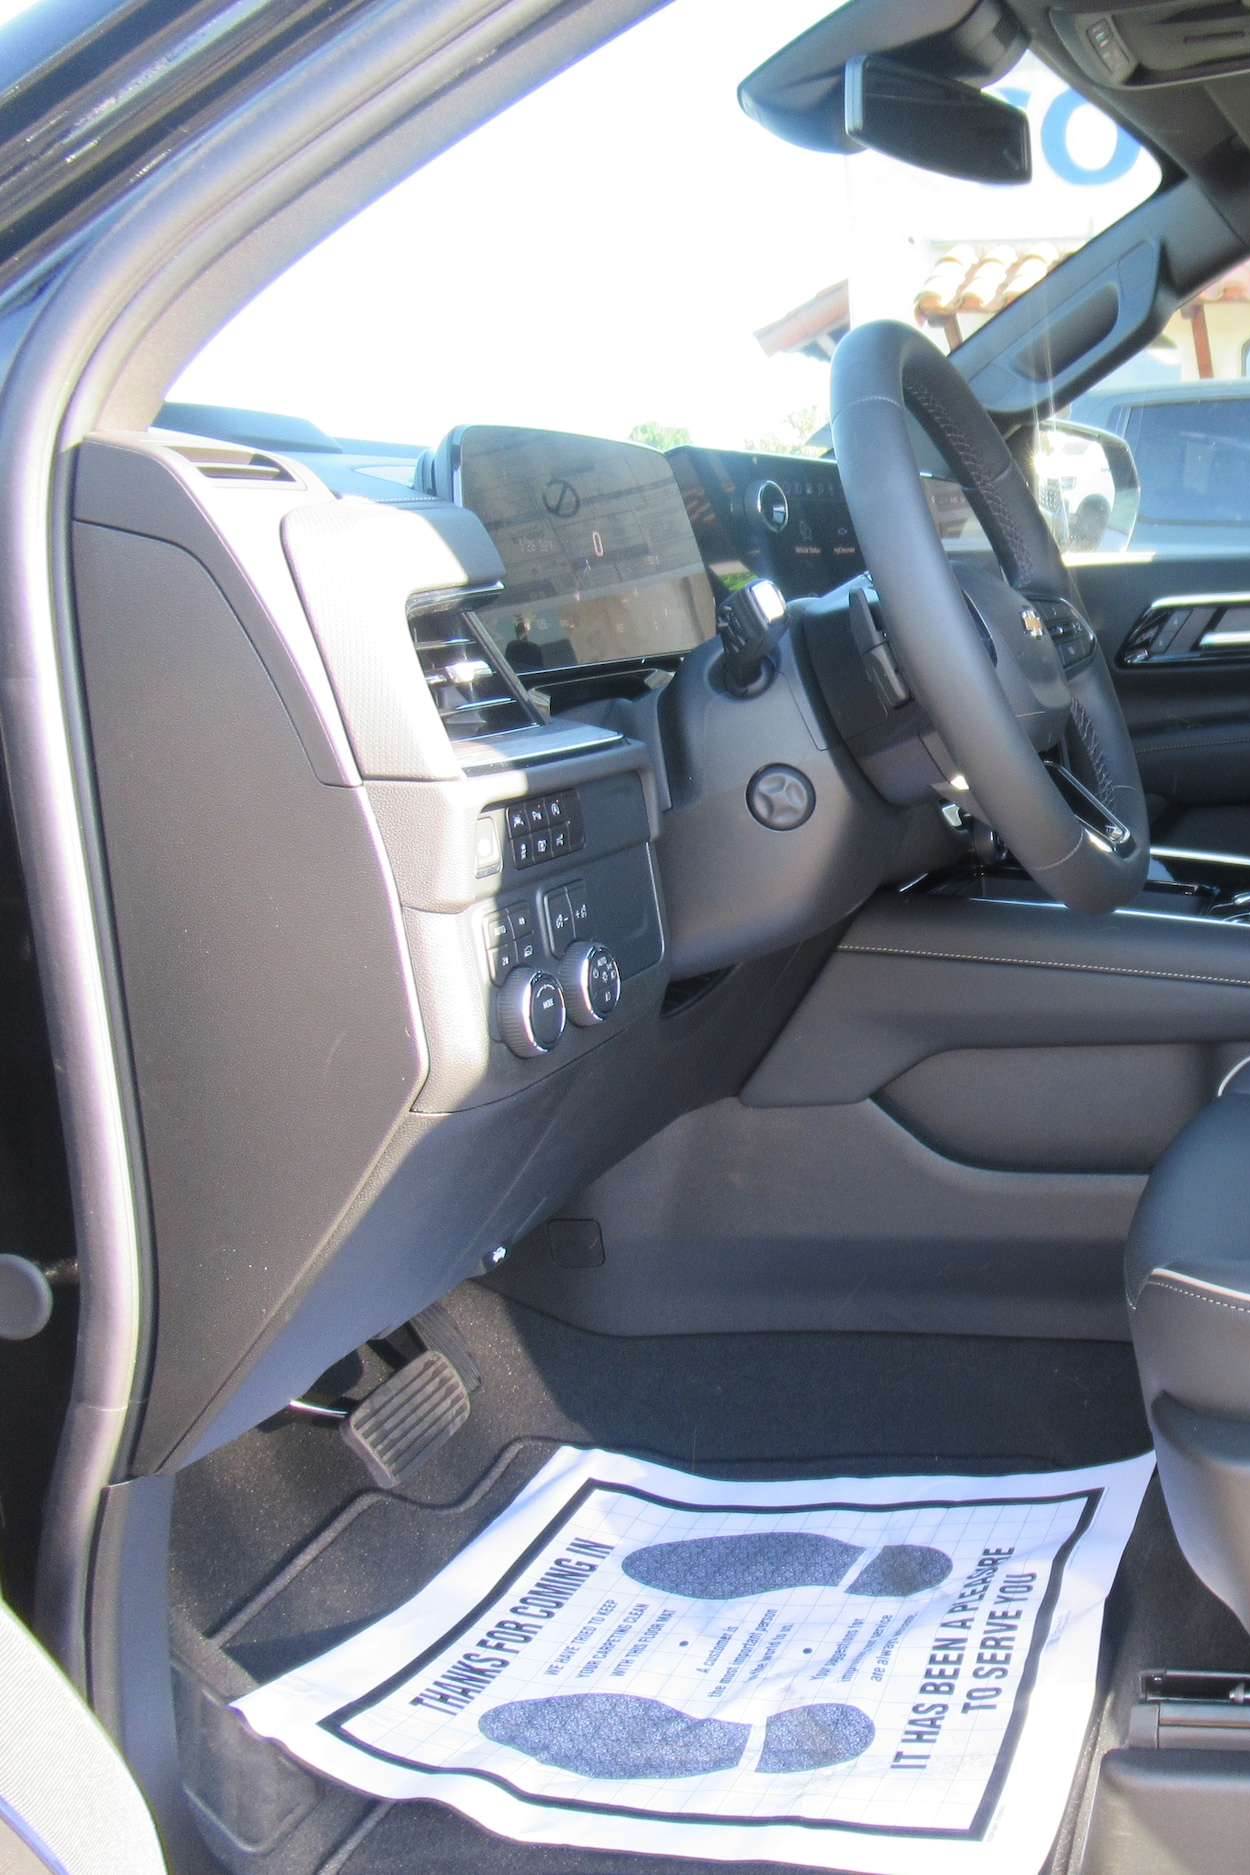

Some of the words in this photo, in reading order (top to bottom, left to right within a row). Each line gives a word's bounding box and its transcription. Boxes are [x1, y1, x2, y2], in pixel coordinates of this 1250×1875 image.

[565, 1537, 615, 1560] IN
[509, 1557, 599, 1620] COMING
[947, 1547, 1015, 1615] PLEASRE
[993, 1572, 1037, 1605] YOU
[587, 1616, 606, 1625] TO
[595, 1599, 619, 1617] KEEP
[755, 1609, 778, 1632] person
[570, 1626, 597, 1645] TRIED
[870, 1614, 893, 1639] service
[940, 1617, 975, 1630] A
[475, 1620, 544, 1654] FOR
[575, 1660, 602, 1679] YOUR
[592, 1624, 632, 1659] CARPETING
[623, 1603, 650, 1624] CLEAN
[609, 1659, 635, 1677] WITH
[624, 1644, 648, 1658] THIS
[638, 1623, 666, 1643] FLOOR
[655, 1609, 677, 1623] MAT
[704, 1632, 733, 1667] customer
[729, 1632, 763, 1665] important
[824, 1629, 859, 1667] suggestions
[848, 1618, 865, 1629] for
[972, 1609, 1023, 1680] SERVE
[554, 1645, 580, 1664] HAVE
[760, 1641, 781, 1662] world
[543, 1664, 564, 1676] WE
[719, 1666, 740, 1684] most
[870, 1666, 886, 1682] are
[919, 1637, 968, 1695] BEEN
[408, 1653, 510, 1716] THANKS
[707, 1685, 727, 1697] the
[961, 1686, 1002, 1714] TO
[901, 1703, 949, 1743] HAS
[890, 1751, 931, 1769] IT
